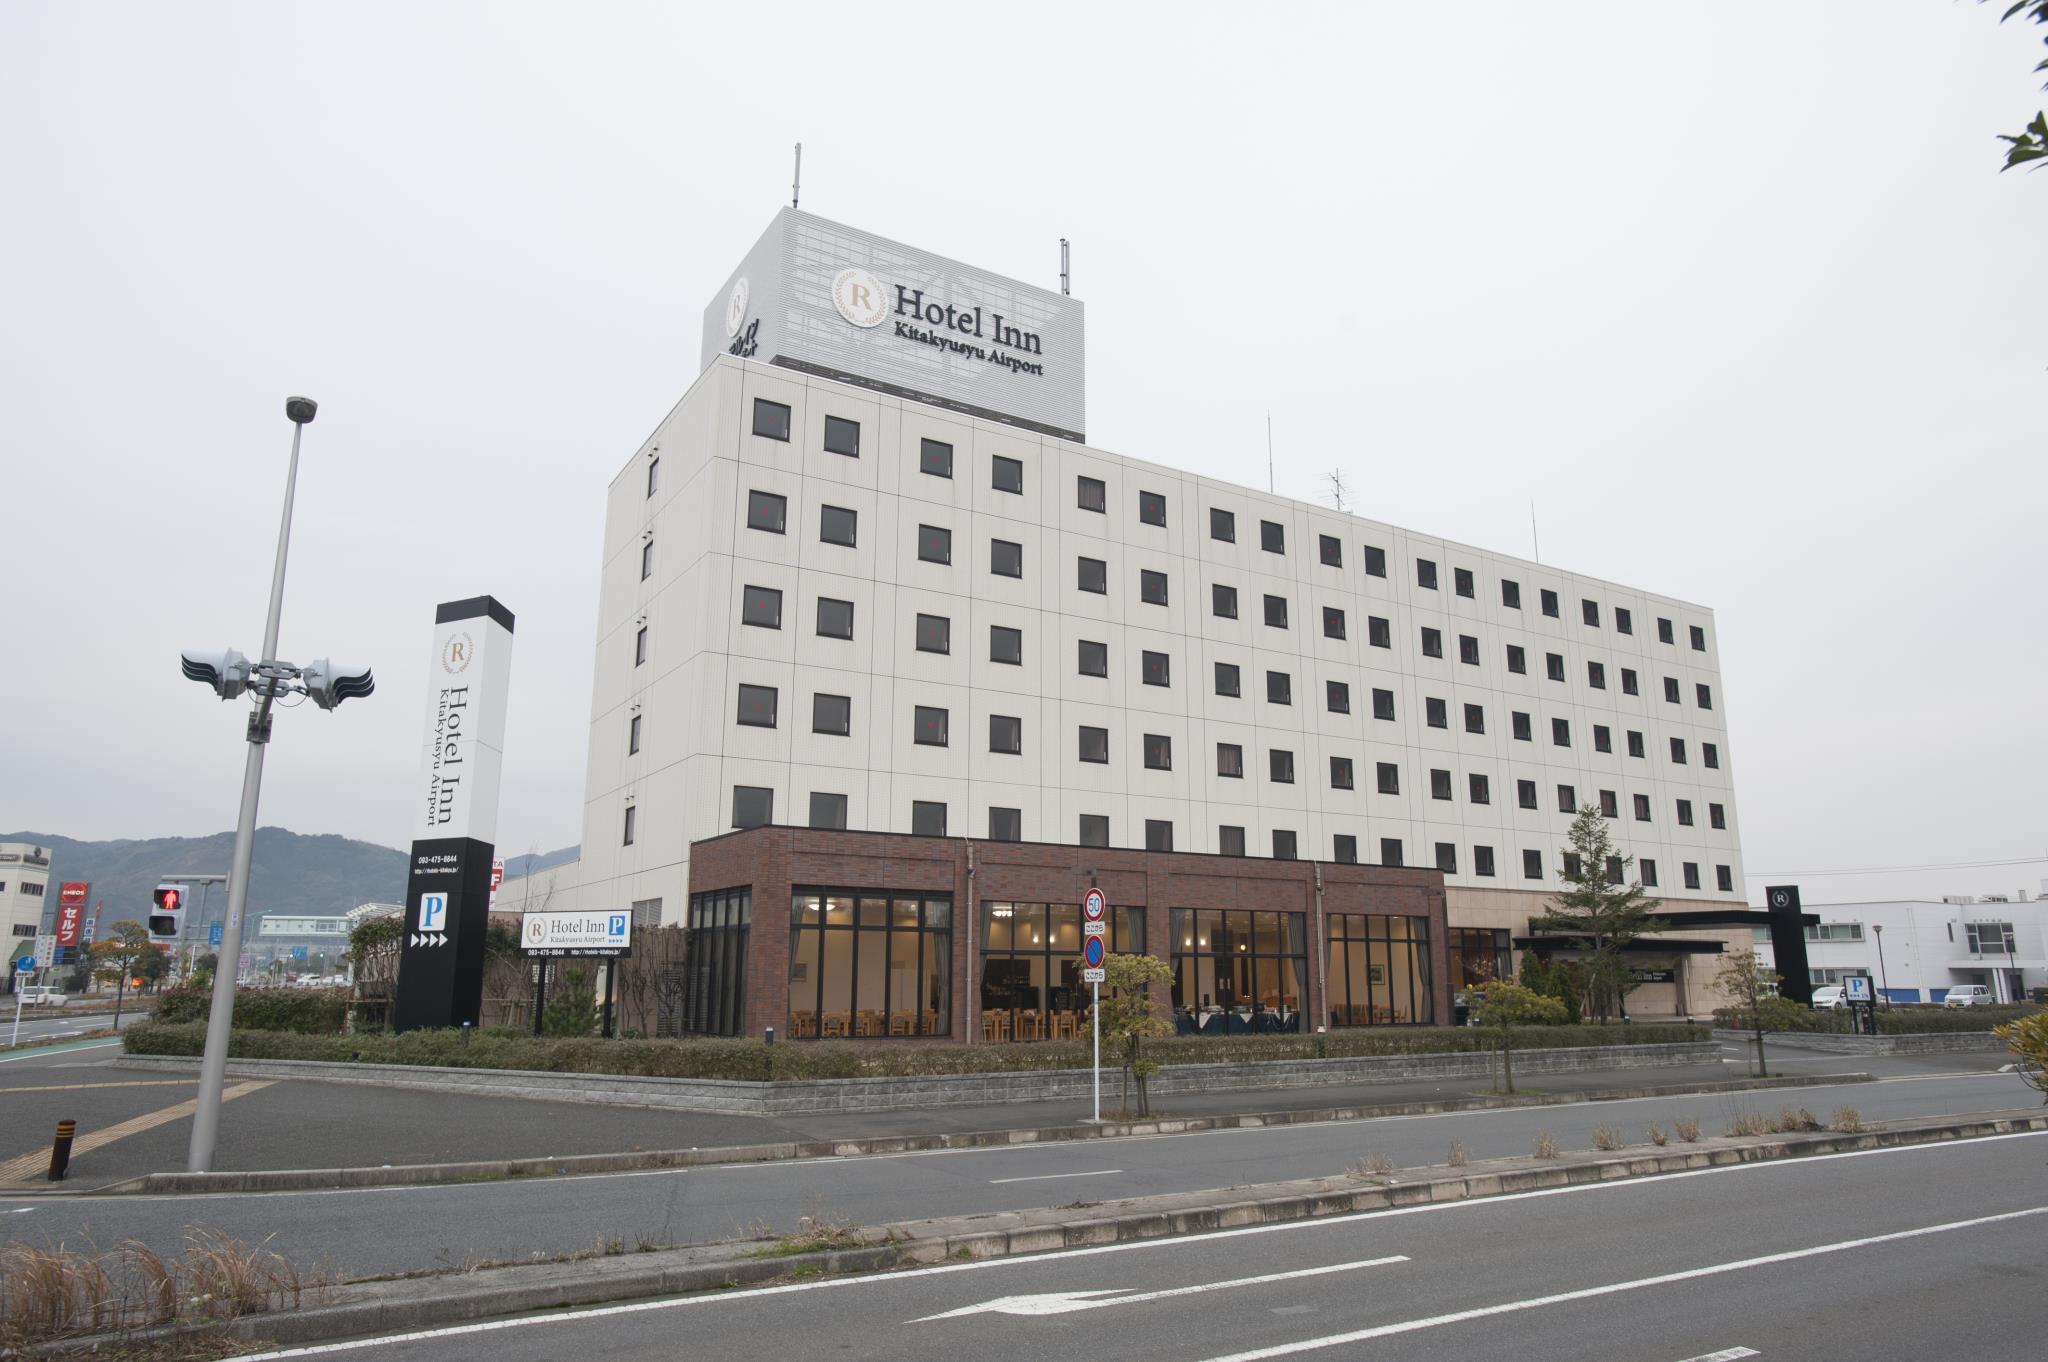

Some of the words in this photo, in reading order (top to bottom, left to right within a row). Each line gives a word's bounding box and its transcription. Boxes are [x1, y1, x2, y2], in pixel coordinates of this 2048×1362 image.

[850, 283, 872, 310] R
[894, 284, 983, 338] Hotel
[992, 314, 1042, 354] Inn
[894, 321, 985, 359] Kitakyusyu
[987, 349, 1044, 376] Airport
[452, 642, 464, 662] R
[431, 688, 450, 770] Kitakyusyu
[443, 683, 469, 767] Hotel
[427, 774, 441, 828] Airport
[438, 775, 461, 825] Inn
[1088, 898, 1100, 912] 50
[1776, 894, 1785, 903] R
[423, 896, 443, 927] P
[61, 907, 77, 942] セルフ
[532, 923, 542, 937] R
[550, 919, 583, 934] Hotel
[586, 919, 606, 934] Inn
[610, 917, 624, 935] P
[1086, 924, 1104, 933] ここから
[584, 936, 606, 945] Airport
[1085, 971, 1104, 980] ここから
[1852, 979, 1863, 992] P
